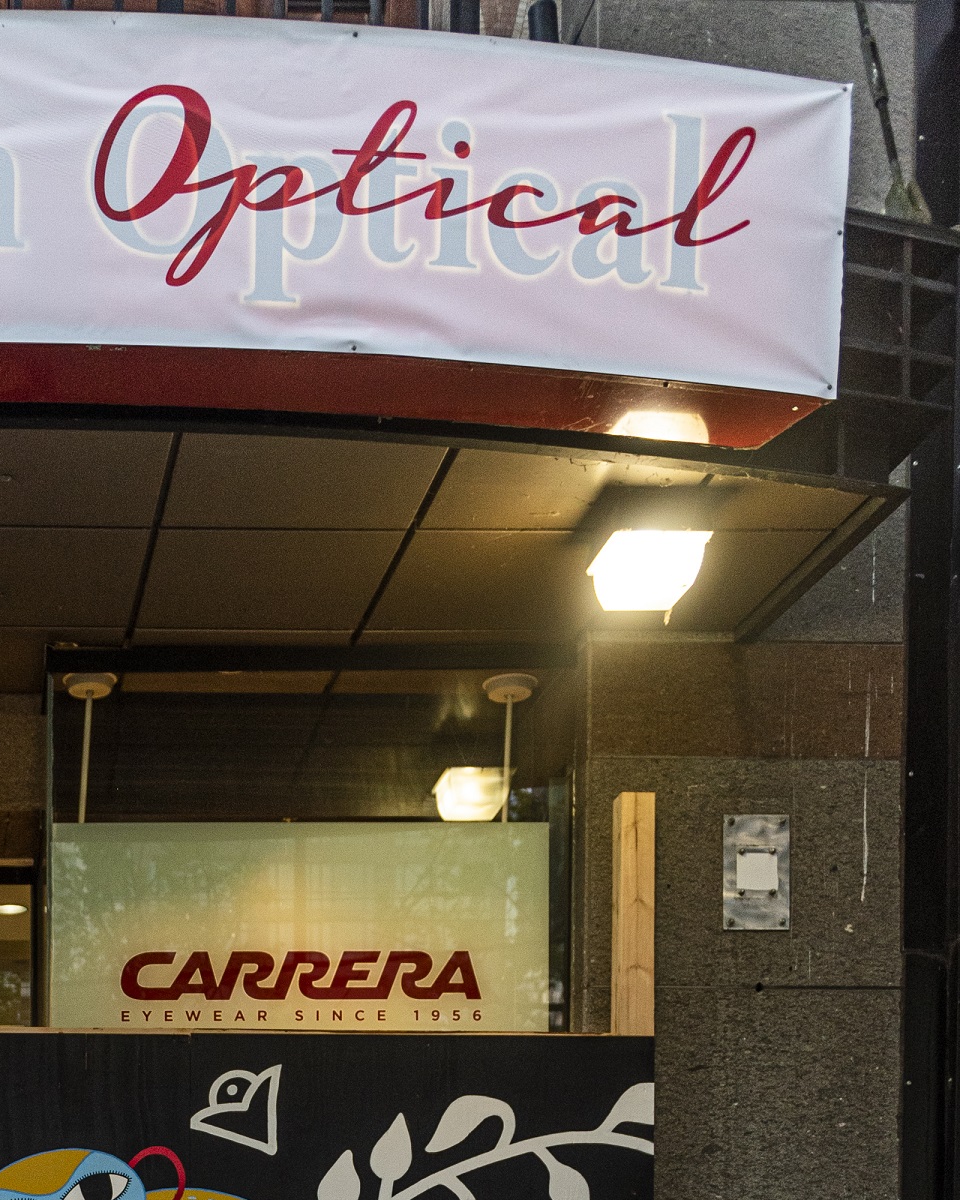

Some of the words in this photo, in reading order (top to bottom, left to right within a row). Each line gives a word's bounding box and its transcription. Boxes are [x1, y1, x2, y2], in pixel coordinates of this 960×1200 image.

[94, 84, 750, 287] Optical
[120, 951, 482, 1000] CARRERA
[121, 1010, 267, 1022] EYEWEAR
[295, 1010, 387, 1021] SINCE
[414, 1010, 482, 1021] 1956
